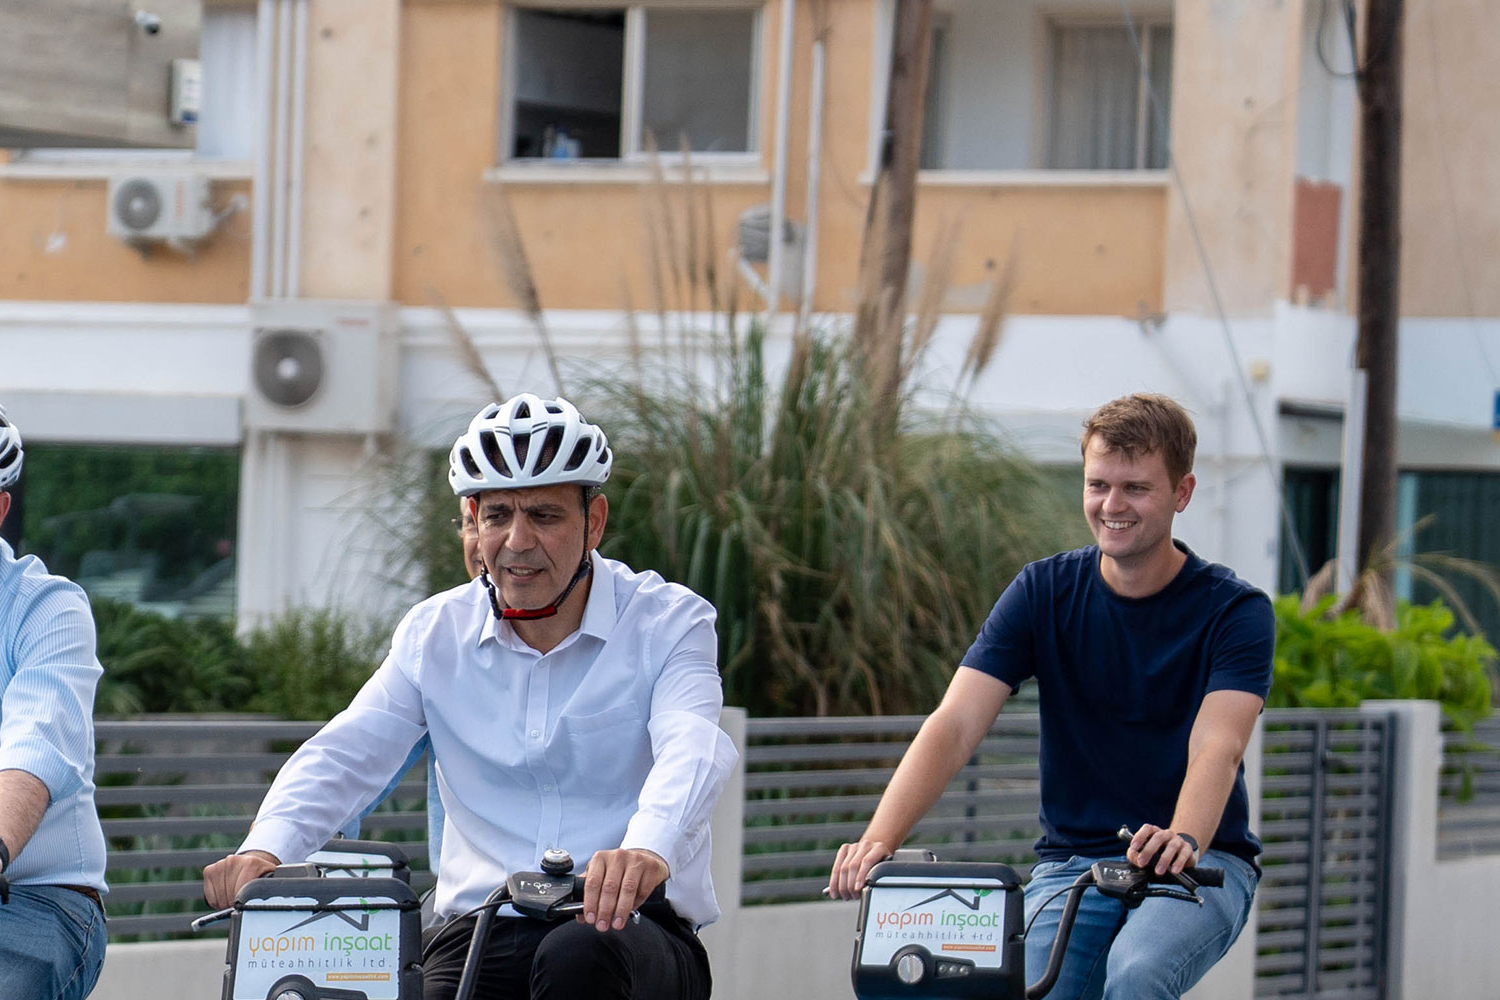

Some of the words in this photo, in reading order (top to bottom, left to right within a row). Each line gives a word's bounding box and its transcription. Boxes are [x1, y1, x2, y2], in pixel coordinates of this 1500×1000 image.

[877, 912, 934, 929] yapım
[941, 910, 999, 931] inşaat
[875, 931, 964, 940] müteahhitlik
[249, 936, 315, 957] yapım
[324, 932, 393, 956] inşaat
[248, 958, 352, 969] müteahhitlik
[363, 957, 392, 968] ltd.
